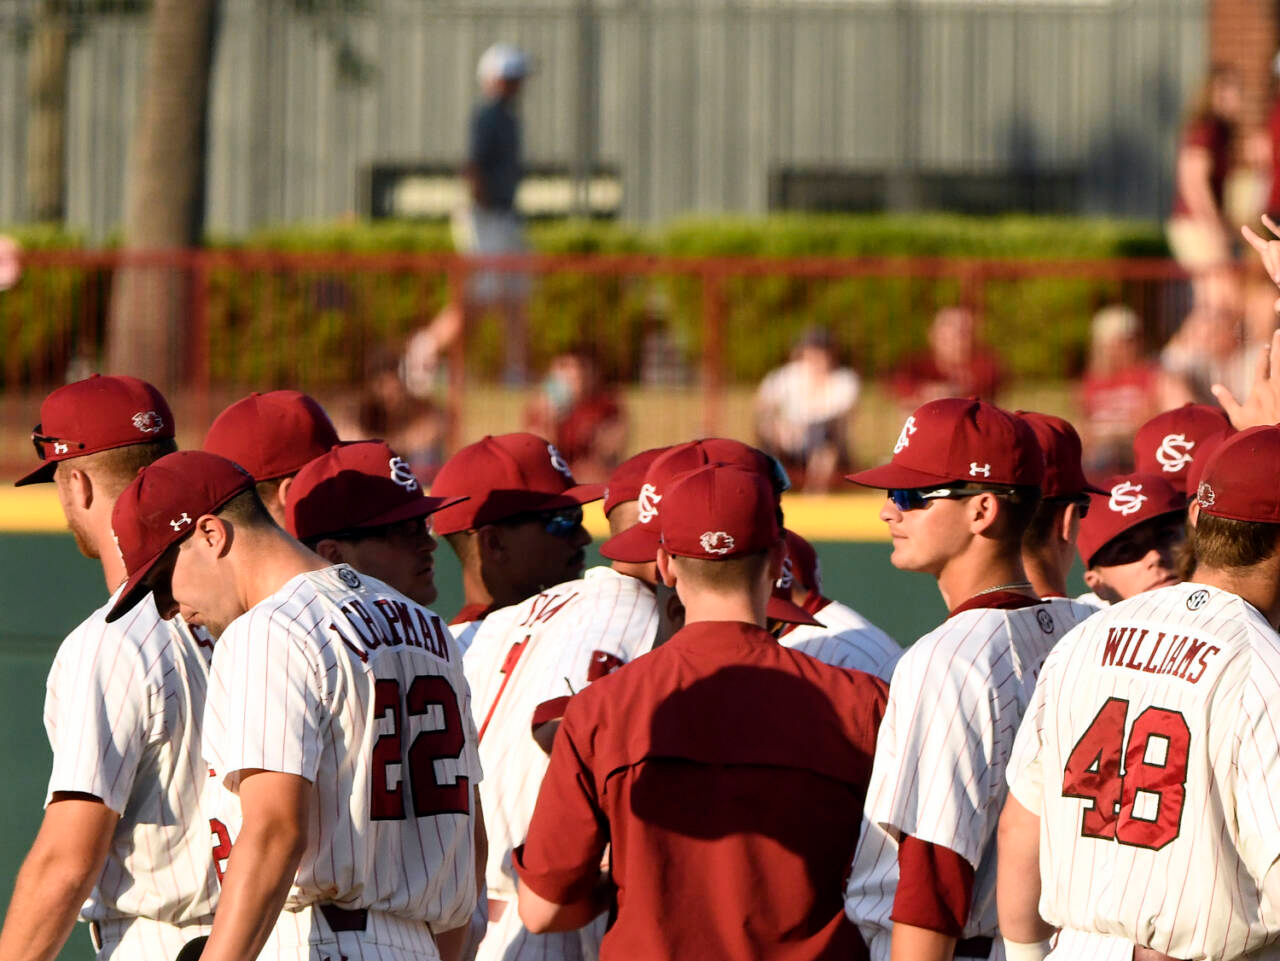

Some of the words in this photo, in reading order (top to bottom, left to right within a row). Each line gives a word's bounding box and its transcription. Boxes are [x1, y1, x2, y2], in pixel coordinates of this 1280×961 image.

[1155, 433, 1195, 472] SC
[1108, 481, 1149, 516] SC
[1101, 627, 1221, 684] WILLIAMS
[370, 675, 470, 821] 22
[1062, 696, 1191, 851] 48
